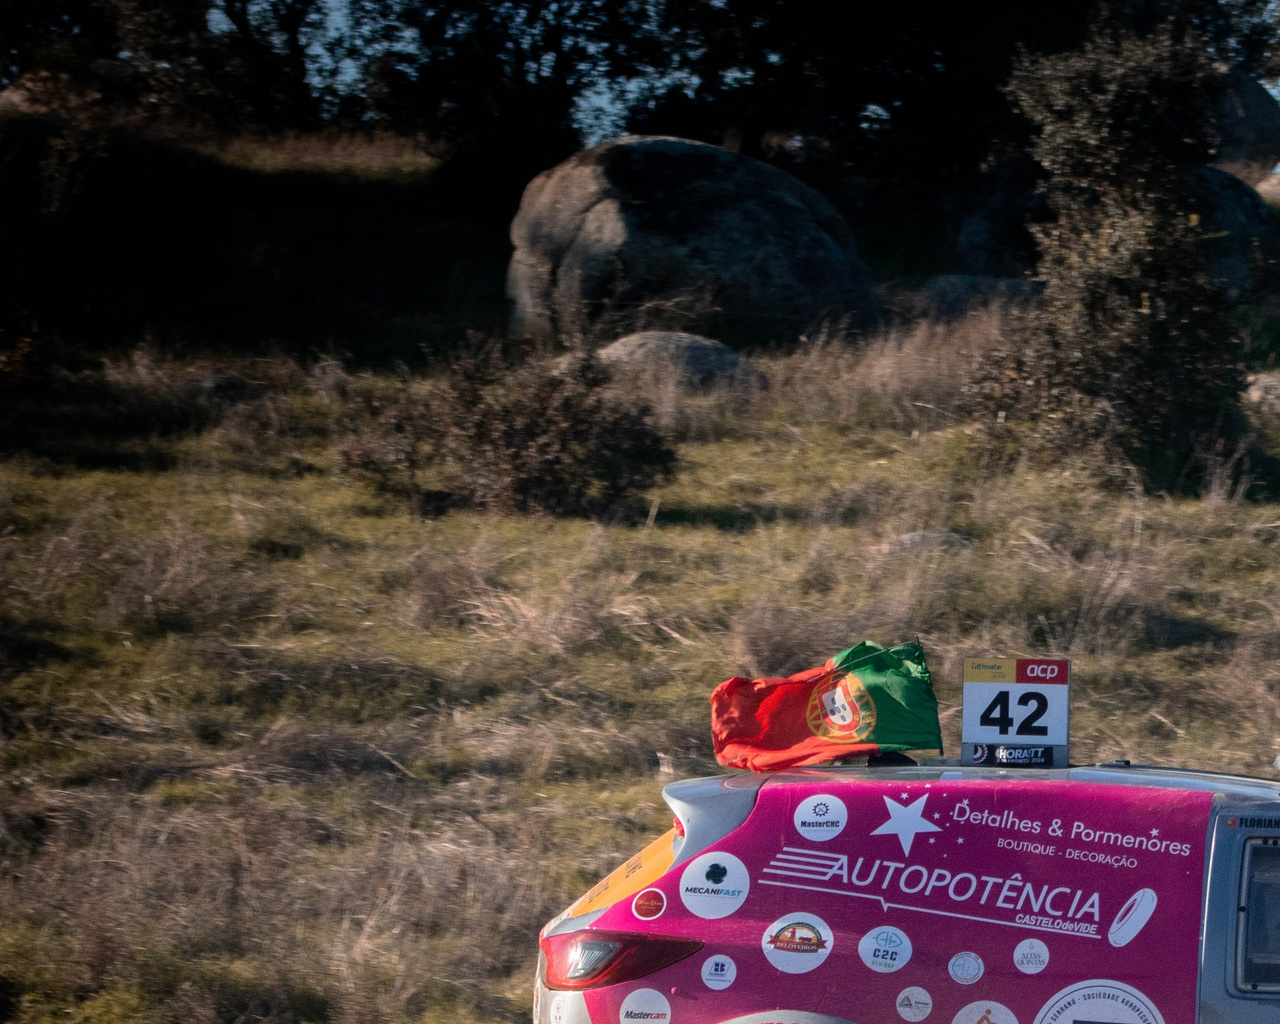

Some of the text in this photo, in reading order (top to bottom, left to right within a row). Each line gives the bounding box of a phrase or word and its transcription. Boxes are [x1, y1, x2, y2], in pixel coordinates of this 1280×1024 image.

[980, 691, 1048, 736] 42
[953, 803, 1191, 857] Detalhes & Pormenores
[997, 838, 1056, 856] BOUTIQUE
[1065, 849, 1138, 868] DECORAÇÃO
[684, 886, 743, 897] MECANIFAST
[823, 854, 1101, 921] AUTOPOTÊNCIA
[775, 941, 818, 951] BELOTEIROS
[873, 948, 898, 961] C2C
[1021, 952, 1042, 960] ALTAS
[1017, 958, 1046, 967] QUINTAS
[1050, 998, 1076, 1022] SERRANO
[1082, 992, 1120, 1002] SOCIEDADE
[623, 1010, 667, 1020] Mastercam
